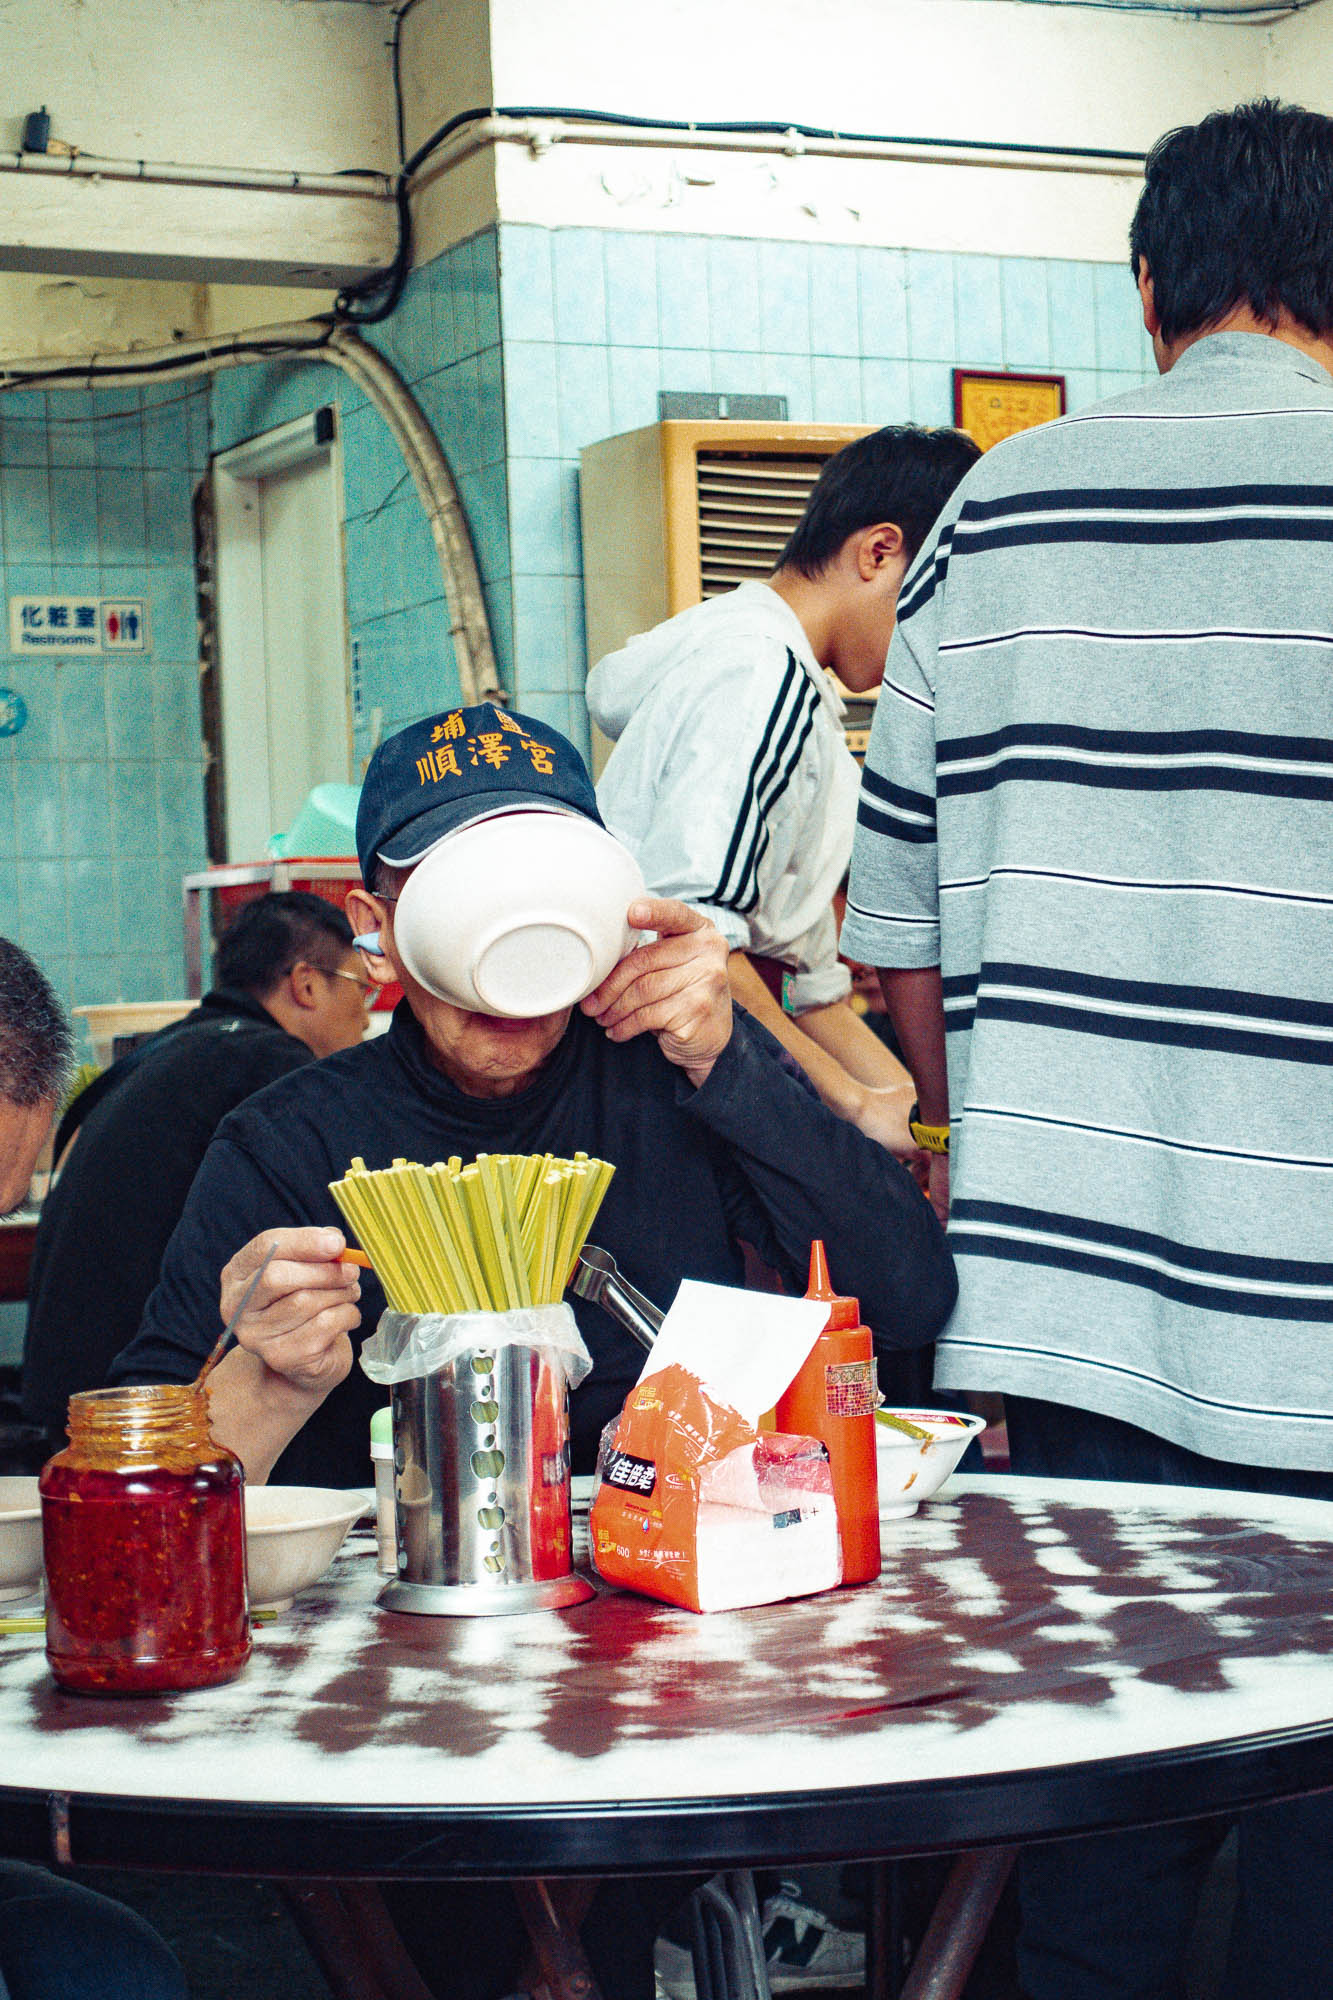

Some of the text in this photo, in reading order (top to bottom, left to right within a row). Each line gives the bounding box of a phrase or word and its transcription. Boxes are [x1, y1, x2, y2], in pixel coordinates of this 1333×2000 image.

[22, 633, 96, 645] Restrooms
[416, 732, 556, 786] 順澤宮
